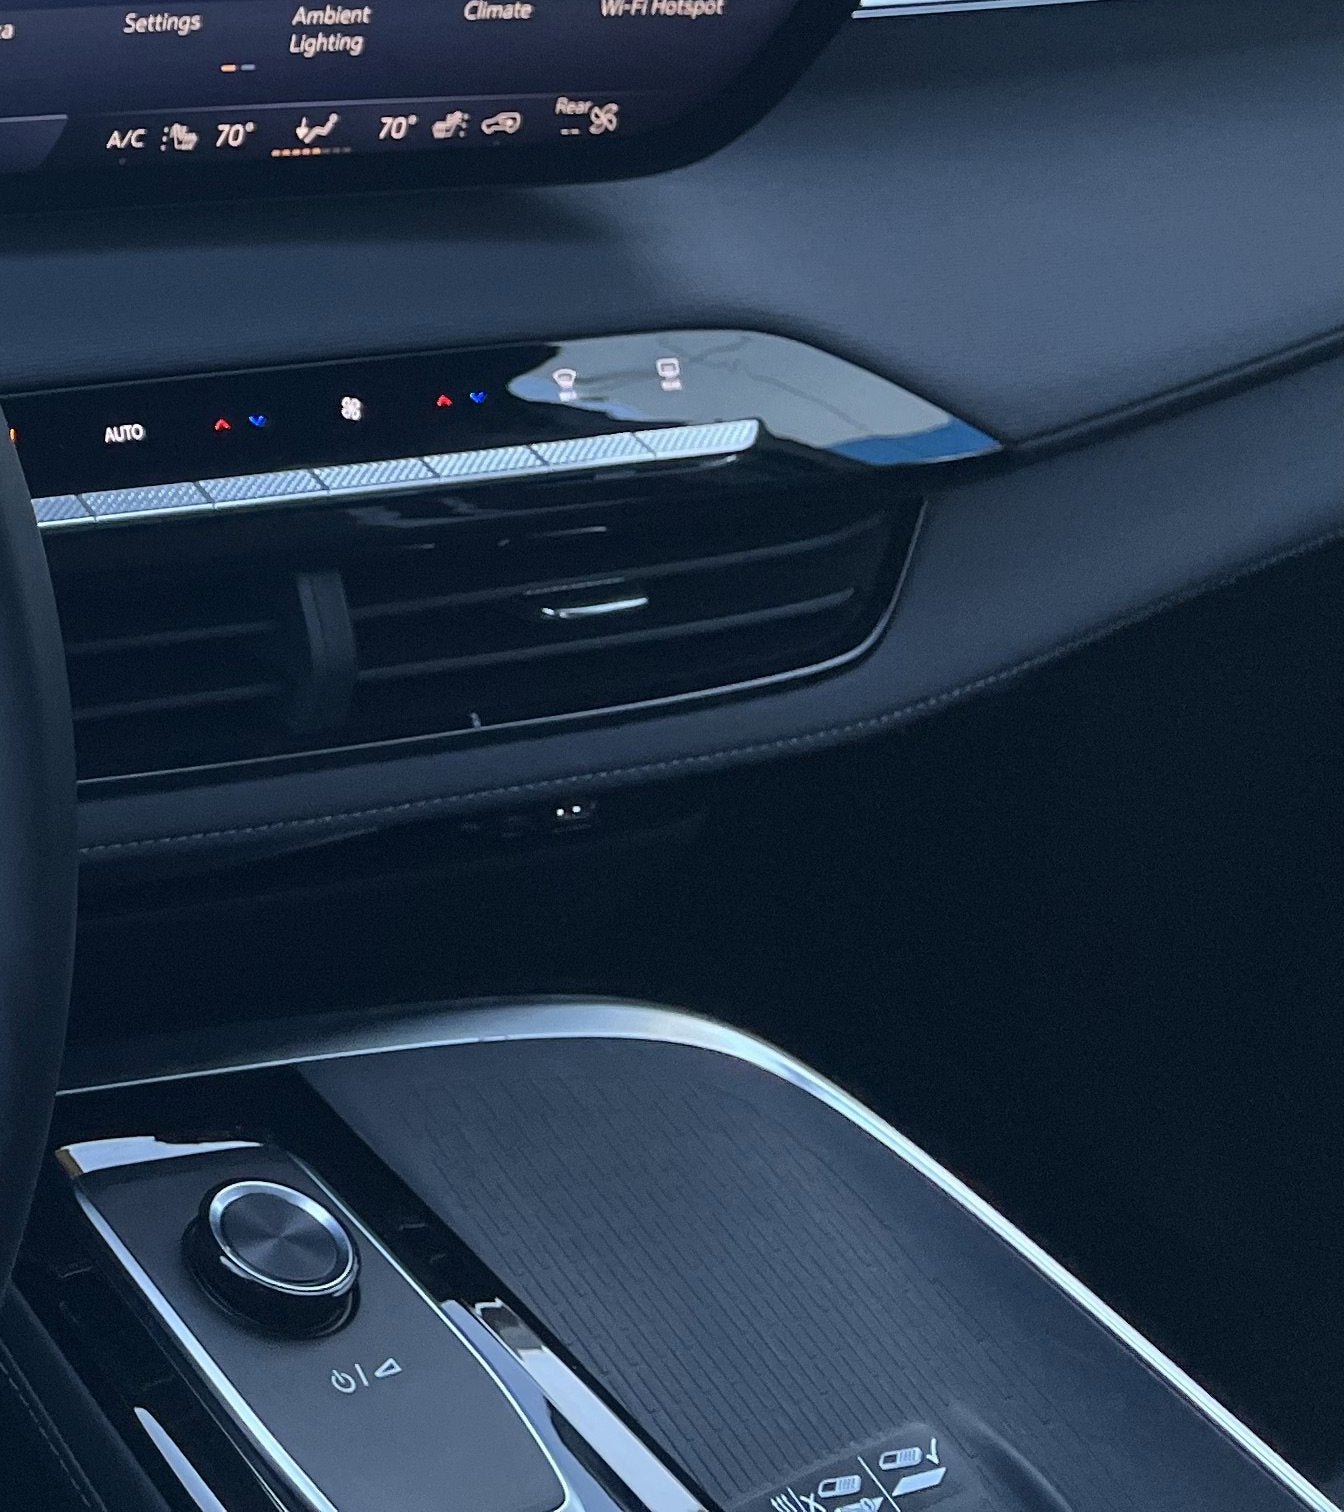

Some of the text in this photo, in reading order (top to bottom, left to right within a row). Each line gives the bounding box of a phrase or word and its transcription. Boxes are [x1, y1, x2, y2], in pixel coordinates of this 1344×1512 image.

[291, 4, 372, 26] Ambient
[463, 0, 533, 21] Climate
[123, 12, 202, 36] Settings
[289, 32, 364, 58] Lighting
[554, 96, 592, 116] Rear
[106, 127, 147, 150] A/C
[215, 121, 255, 148] 70°
[378, 114, 417, 140] 70°
[104, 422, 146, 445] AUTO
